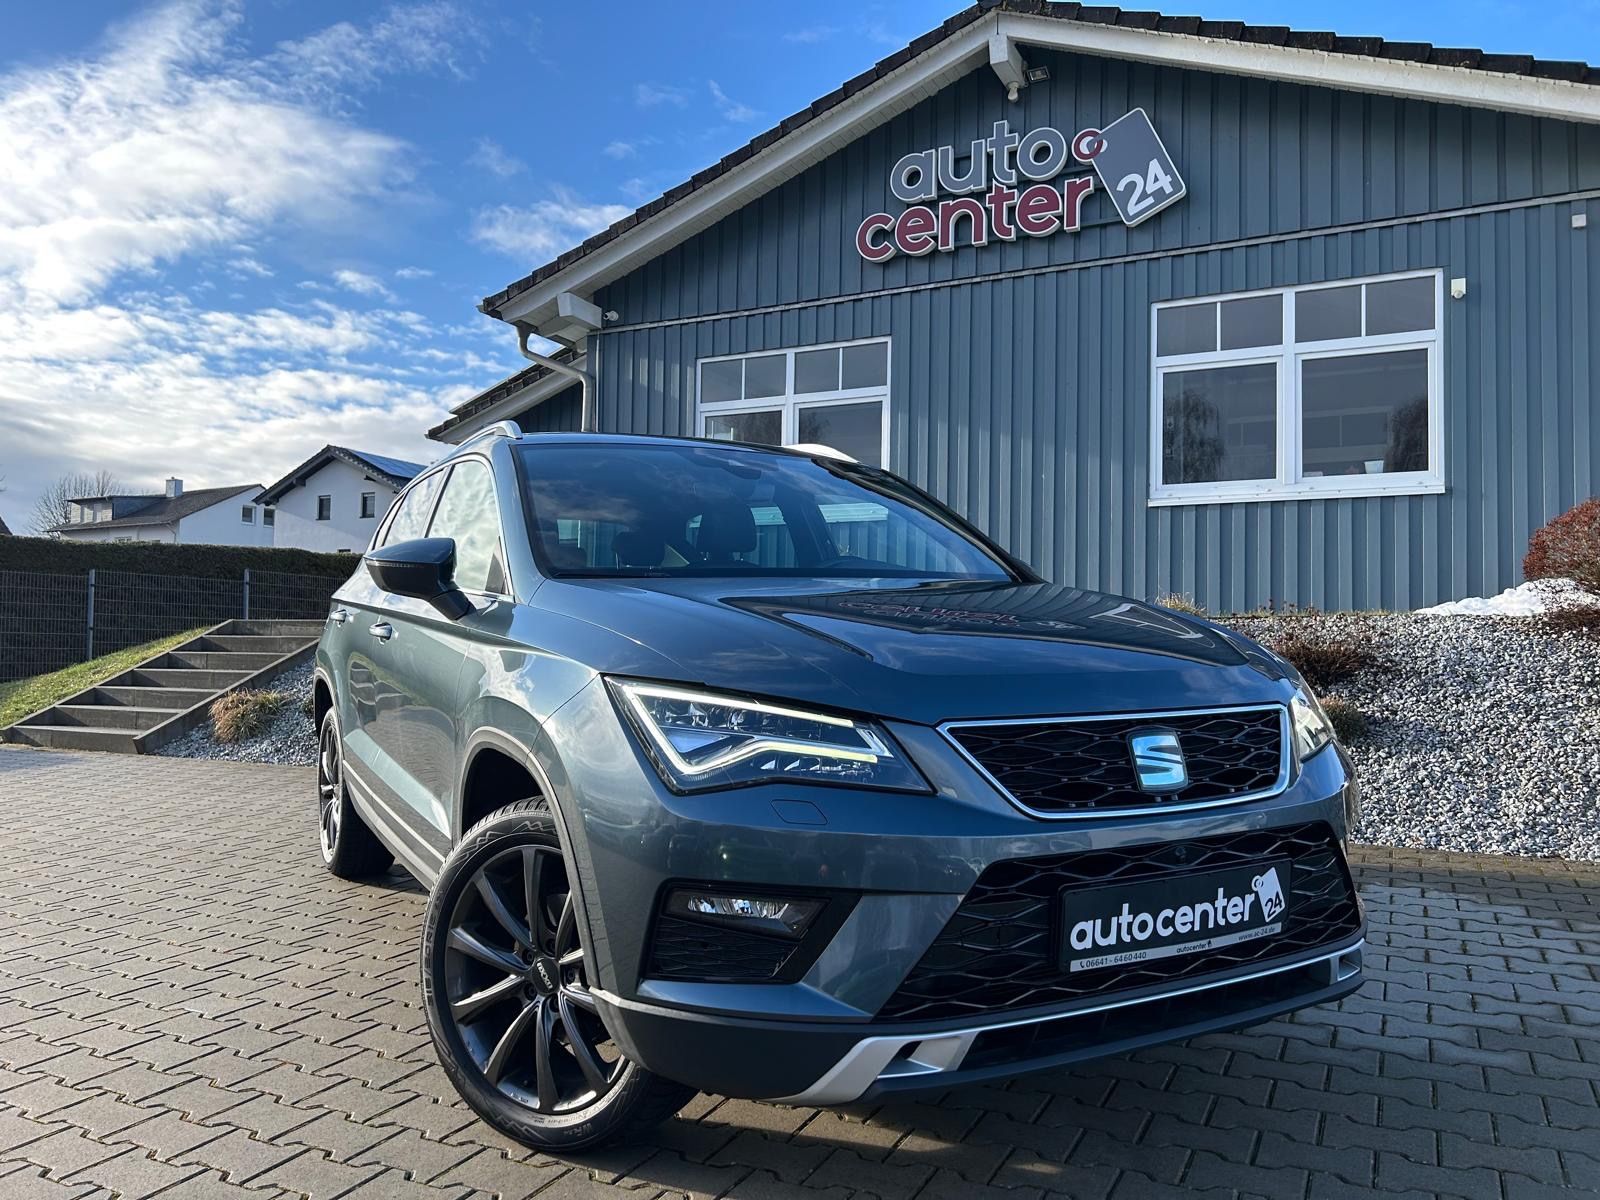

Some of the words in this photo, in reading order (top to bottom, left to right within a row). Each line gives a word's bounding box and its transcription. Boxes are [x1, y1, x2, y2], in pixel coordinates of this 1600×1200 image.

[890, 119, 1066, 201] auto
[1116, 158, 1174, 216] 24
[856, 176, 1094, 263] center
[1070, 888, 1255, 950] autocenter
[1265, 891, 1282, 919] 24
